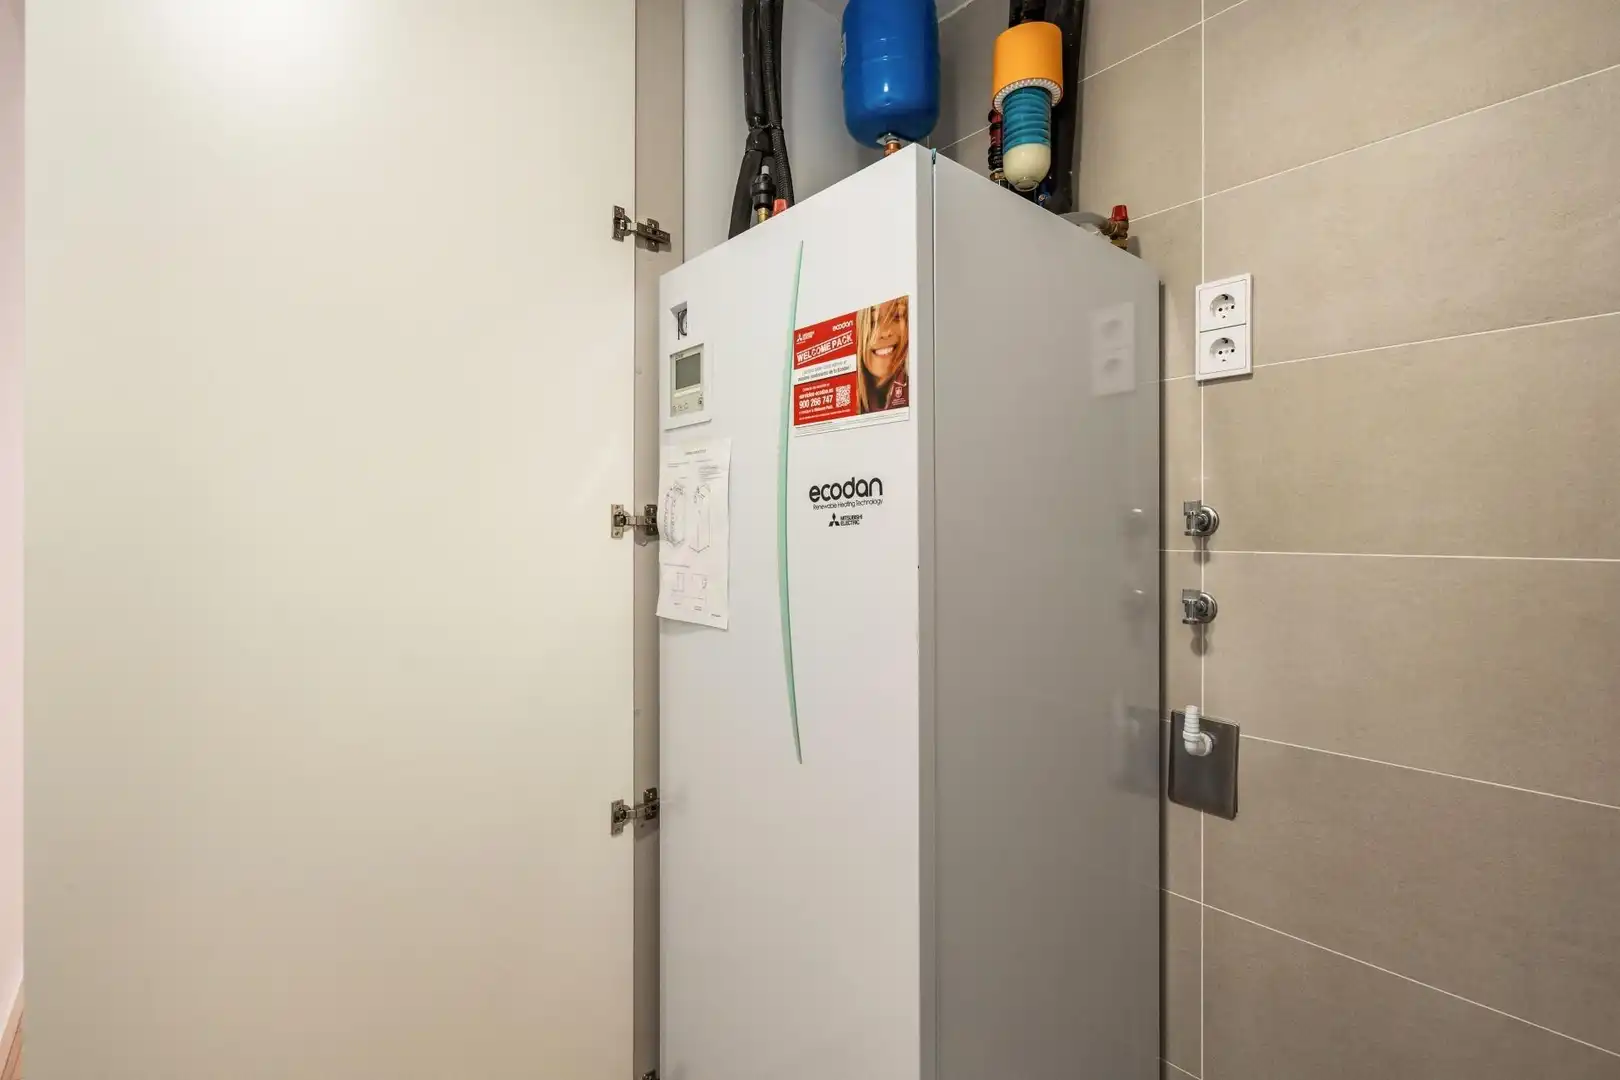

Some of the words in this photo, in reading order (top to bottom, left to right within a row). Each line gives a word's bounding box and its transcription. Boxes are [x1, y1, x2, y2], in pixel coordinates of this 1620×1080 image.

[797, 343, 831, 362] WELCOME
[832, 333, 853, 348] PACK
[799, 400, 810, 409] 900
[823, 395, 833, 404] 747
[809, 476, 883, 503] ecodan
[838, 500, 855, 508] Heating
